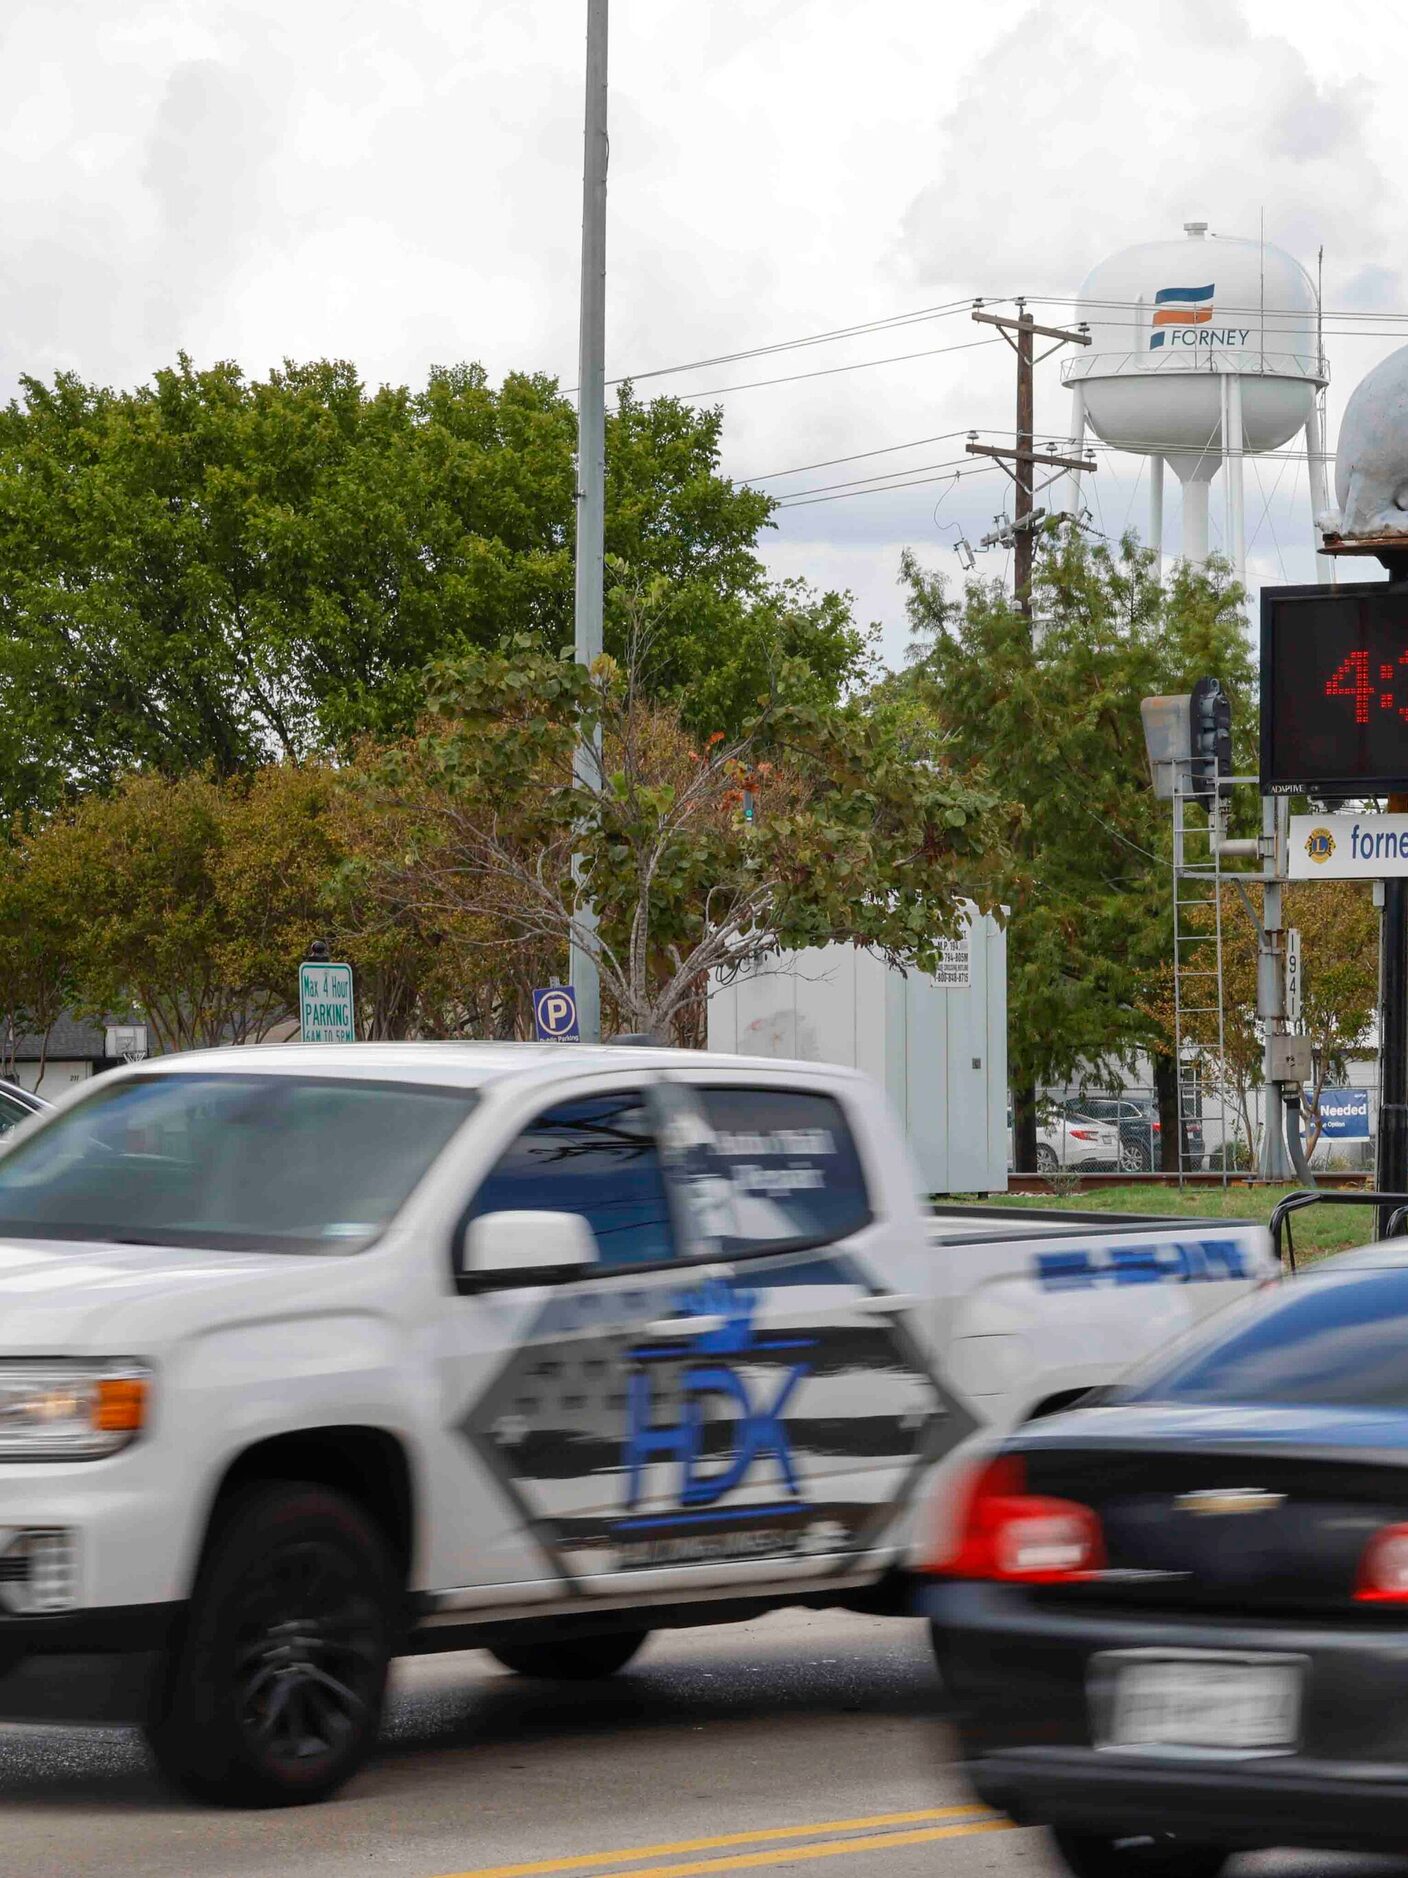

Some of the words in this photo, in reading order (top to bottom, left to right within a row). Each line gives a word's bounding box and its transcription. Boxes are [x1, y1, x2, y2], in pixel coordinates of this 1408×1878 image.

[1171, 329, 1249, 346] FORNEY
[1271, 784, 1305, 793] ADAPTIVE
[304, 975, 318, 998] Max
[323, 976, 328, 997] 4
[332, 975, 348, 998] Hour
[305, 1003, 348, 1026] PARKING
[547, 999, 567, 1029] P
[557, 1034, 579, 1042] Parking
[1320, 1103, 1367, 1116] Needed
